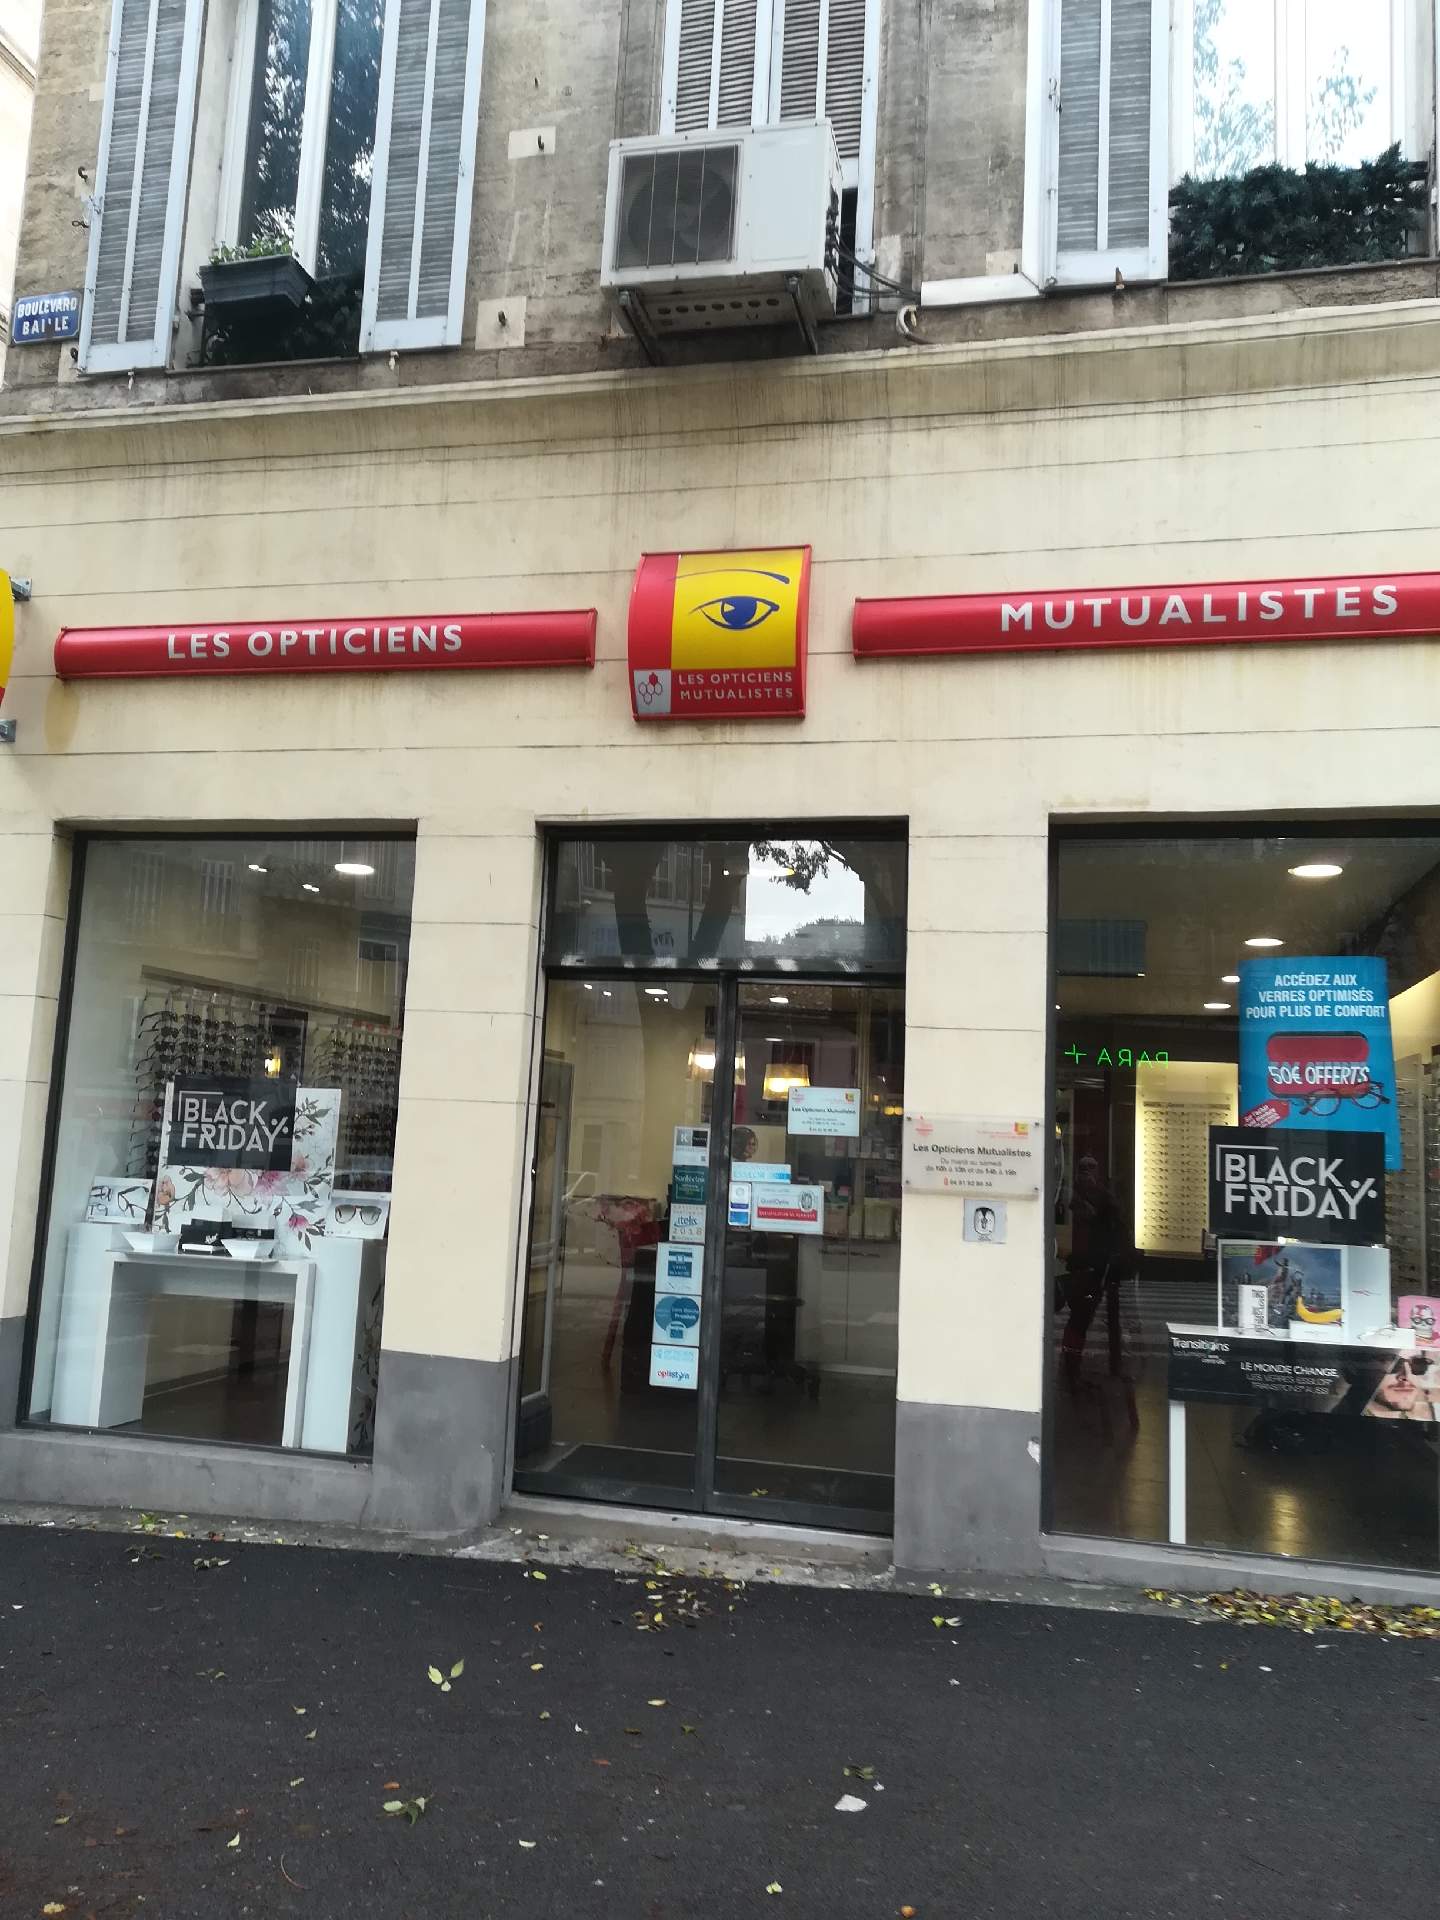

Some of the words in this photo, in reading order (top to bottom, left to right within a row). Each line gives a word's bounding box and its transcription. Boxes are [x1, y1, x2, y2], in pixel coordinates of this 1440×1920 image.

[17, 297, 77, 318] BOULEVARD
[22, 316, 68, 335] BAILE
[1001, 584, 1398, 631] MUTUALISTES
[168, 632, 230, 659] LES
[247, 624, 462, 656] OPTICIENS
[678, 673, 704, 685] LES
[711, 672, 793, 684] OPTICIENS
[680, 688, 793, 700] MUTUALISTES
[1274, 972, 1331, 986] ACCÉDEZ
[1333, 974, 1358, 986] AUX
[1258, 990, 1306, 1003] VERRES
[1308, 987, 1374, 1002] OPTIMISÉS
[1246, 1006, 1277, 1019] POUR
[1279, 1005, 1312, 1017] PLUS
[1315, 1005, 1332, 1017] DE
[1334, 1005, 1386, 1018] CONFORT
[1268, 1066, 1303, 1085] 50€
[1305, 1066, 1370, 1085] OFFERTS
[184, 1097, 267, 1125] BLACK
[181, 1116, 289, 1153] FRIDAY
[913, 1143, 929, 1151] Les
[932, 1144, 975, 1156] Opticiens
[977, 1147, 1032, 1158] Mutualistes
[1225, 1153, 1344, 1187] BLACK
[1225, 1178, 1376, 1219] FRIDAY
[1240, 1361, 1252, 1371] LE
[1254, 1363, 1292, 1374] MONDE
